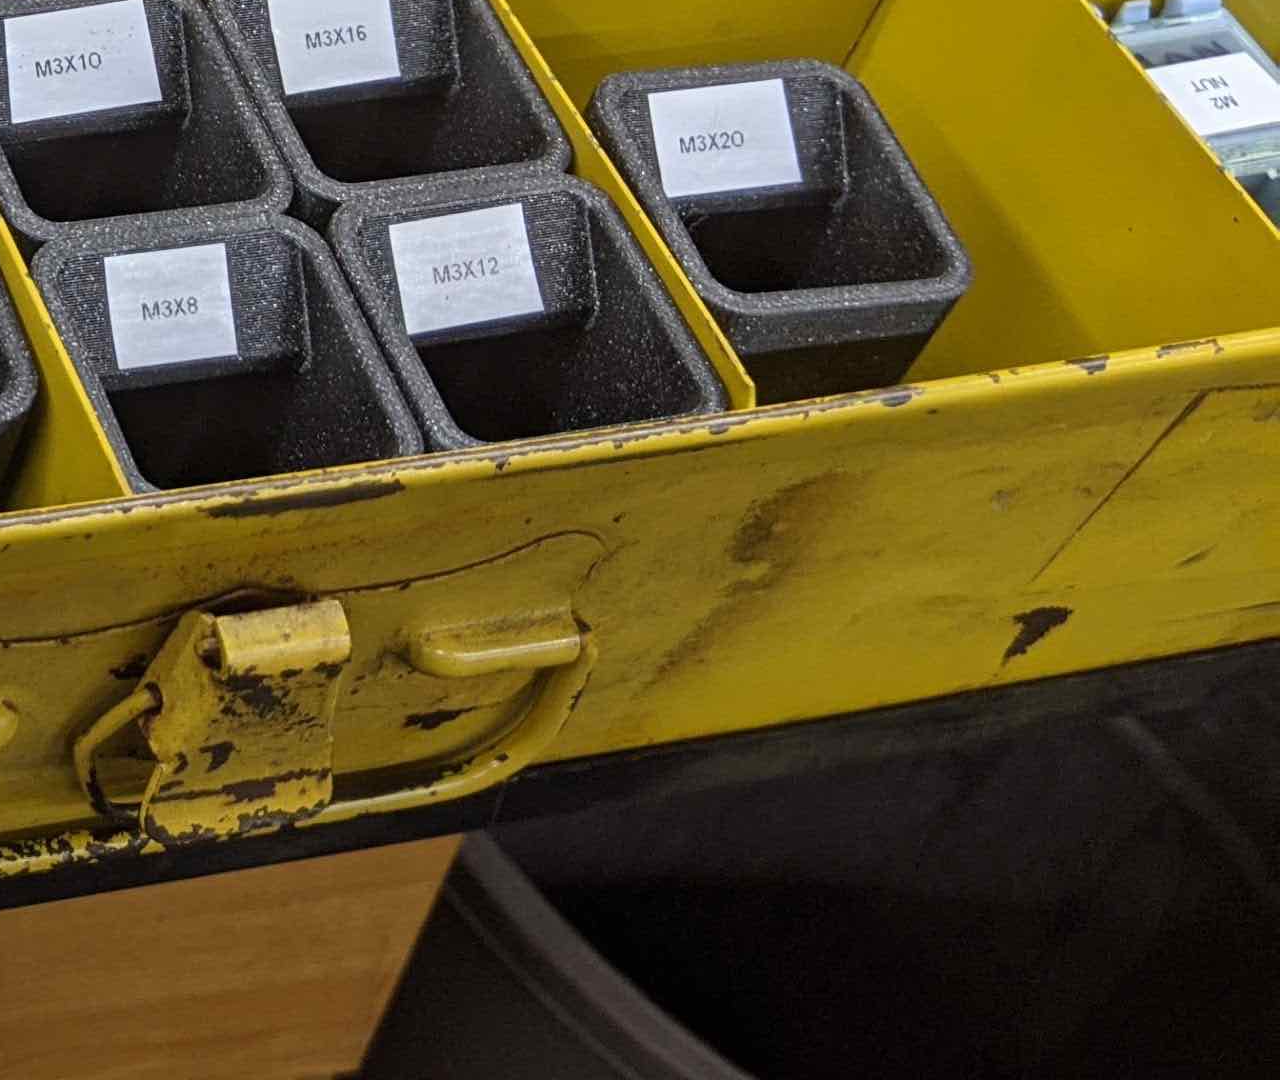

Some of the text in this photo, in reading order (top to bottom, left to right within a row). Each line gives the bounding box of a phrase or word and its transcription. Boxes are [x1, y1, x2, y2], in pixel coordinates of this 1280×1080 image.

[305, 24, 368, 50] M3X16
[34, 51, 102, 79] M3X10
[1189, 75, 1230, 94] NUT
[679, 130, 745, 154] M3X20
[432, 256, 500, 285] M3X12
[141, 296, 199, 321] M3X8
